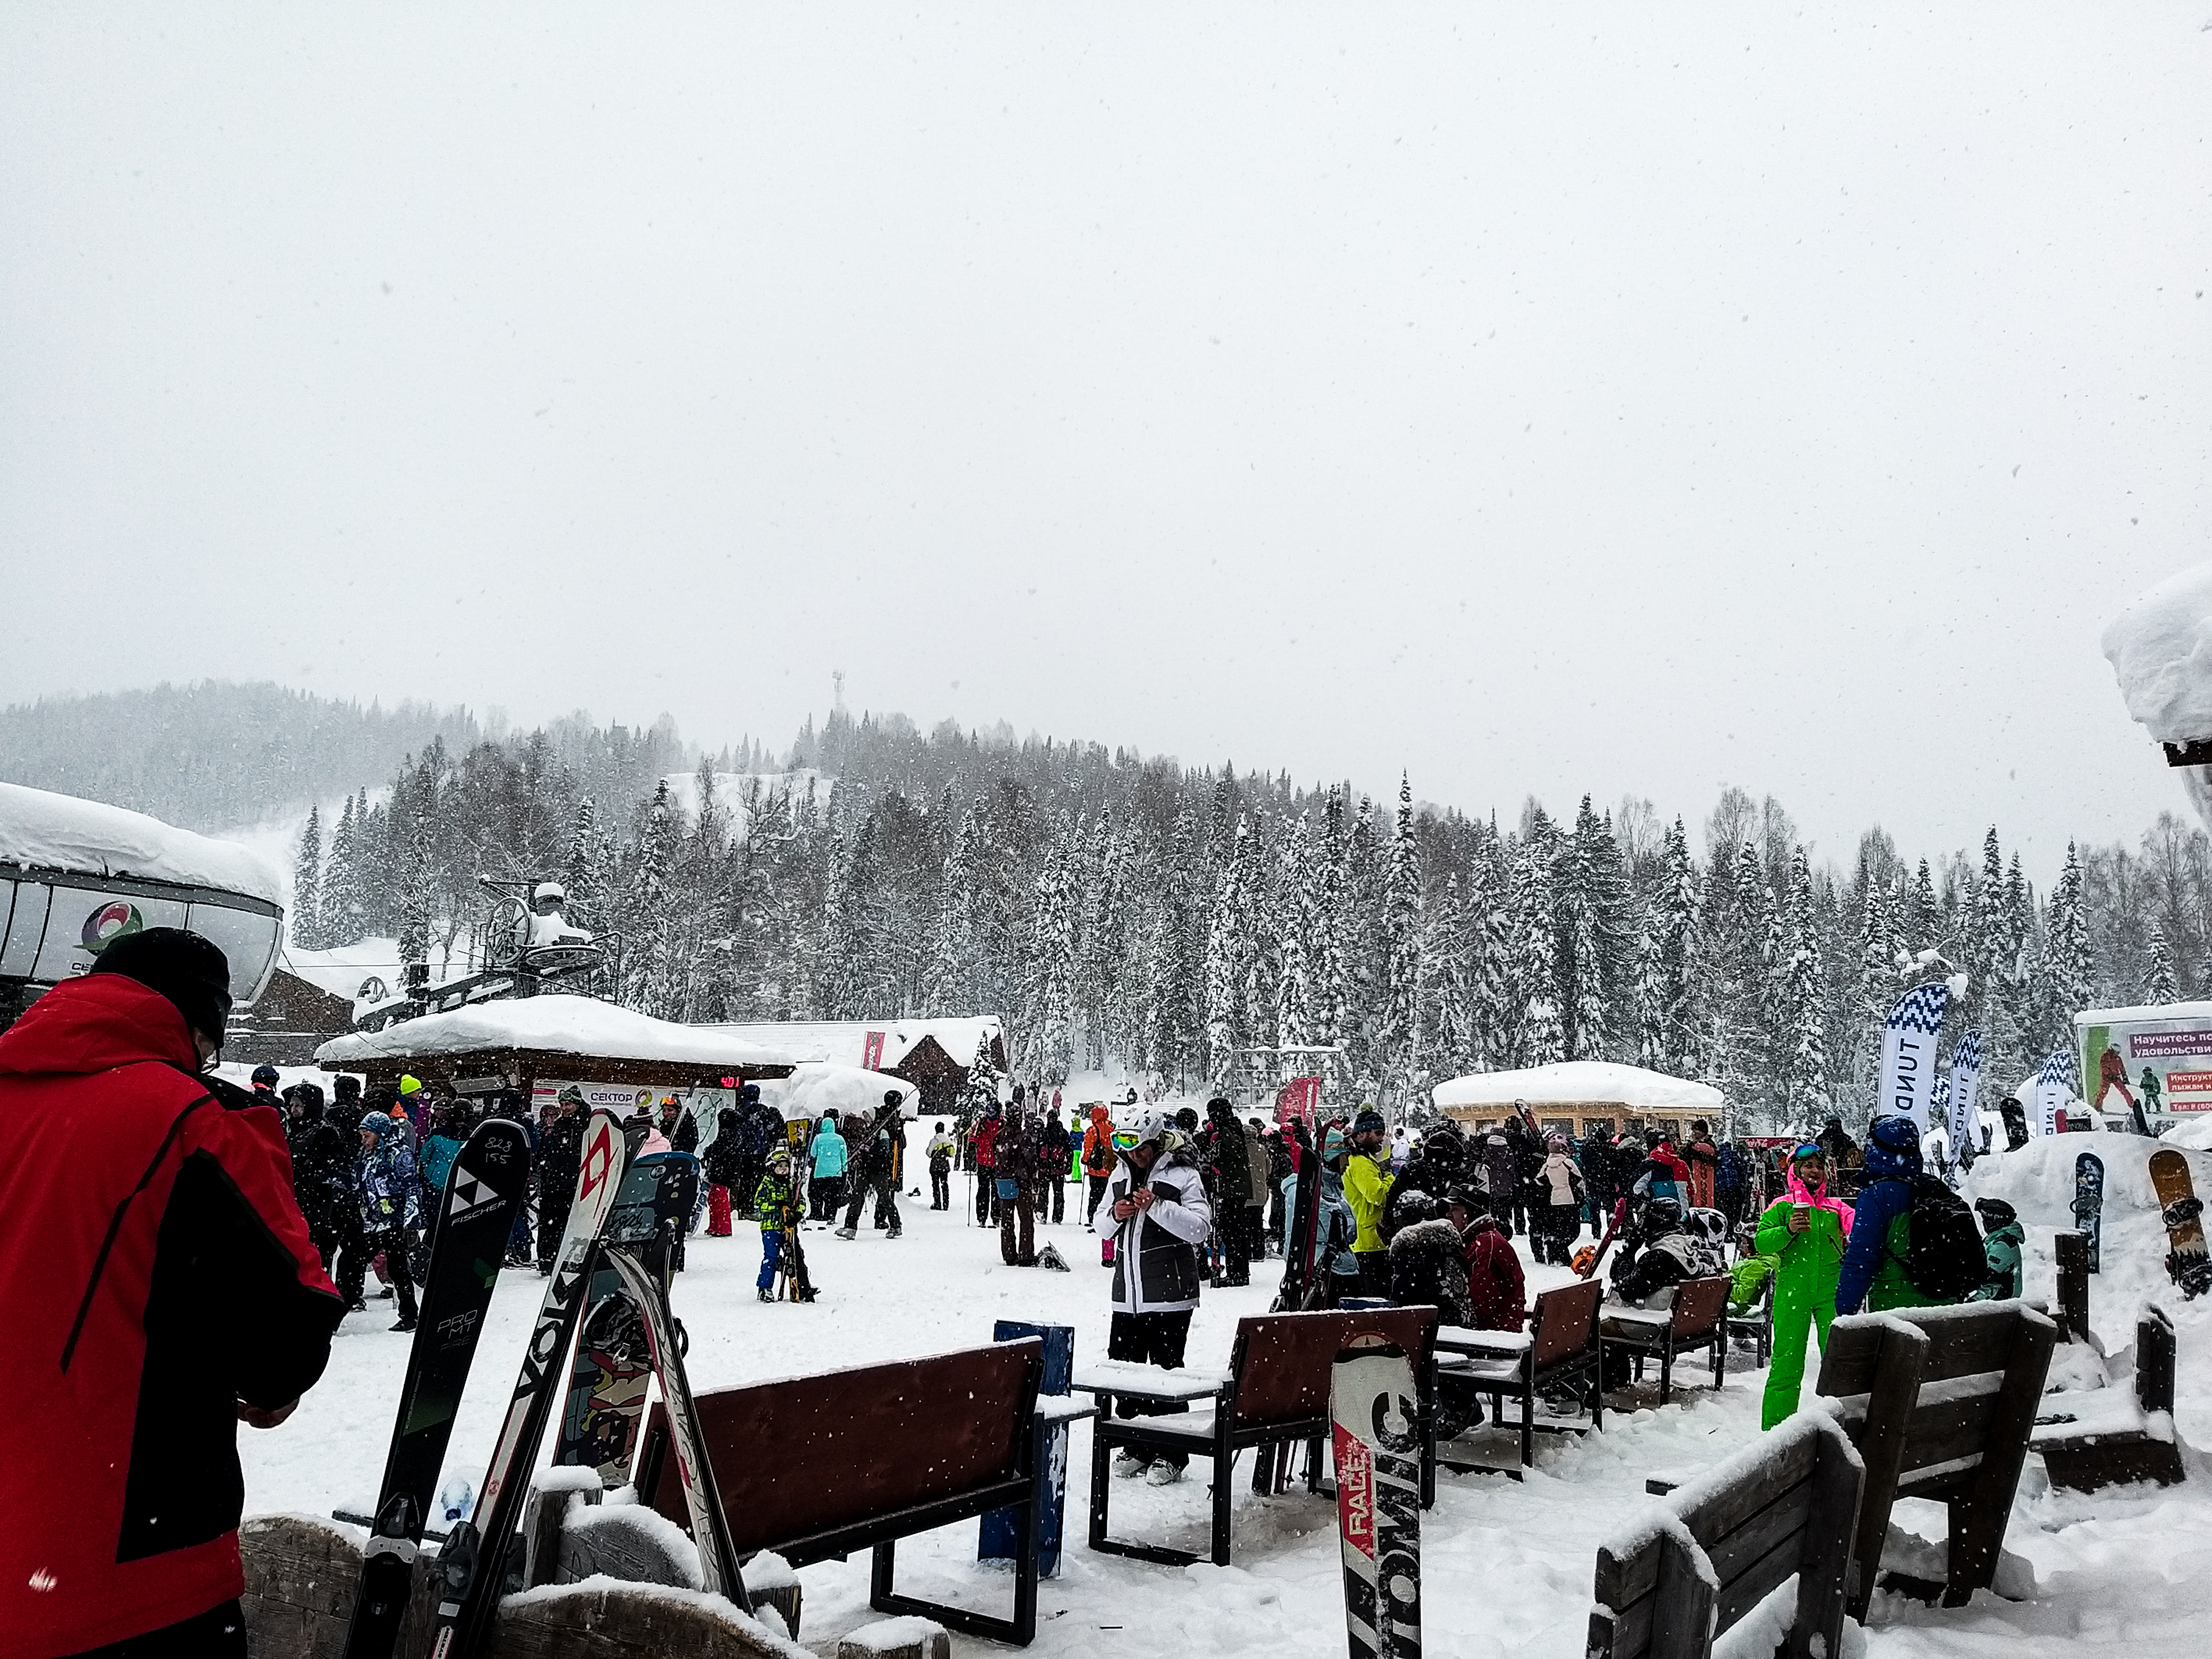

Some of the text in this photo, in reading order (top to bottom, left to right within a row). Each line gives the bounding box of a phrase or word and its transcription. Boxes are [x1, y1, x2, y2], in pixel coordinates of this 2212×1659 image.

[2134, 1035, 2196, 1045] Научитесь
[2135, 1046, 2212, 1057] удовольстви
[590, 1092, 633, 1102] СЕКТОР
[485, 1137, 512, 1152] 828
[485, 1153, 512, 1164] 155
[451, 1200, 507, 1226] FISCHER
[437, 1309, 478, 1333] PRO
[448, 1320, 476, 1339] MT
[1348, 1449, 1368, 1536] RACE
